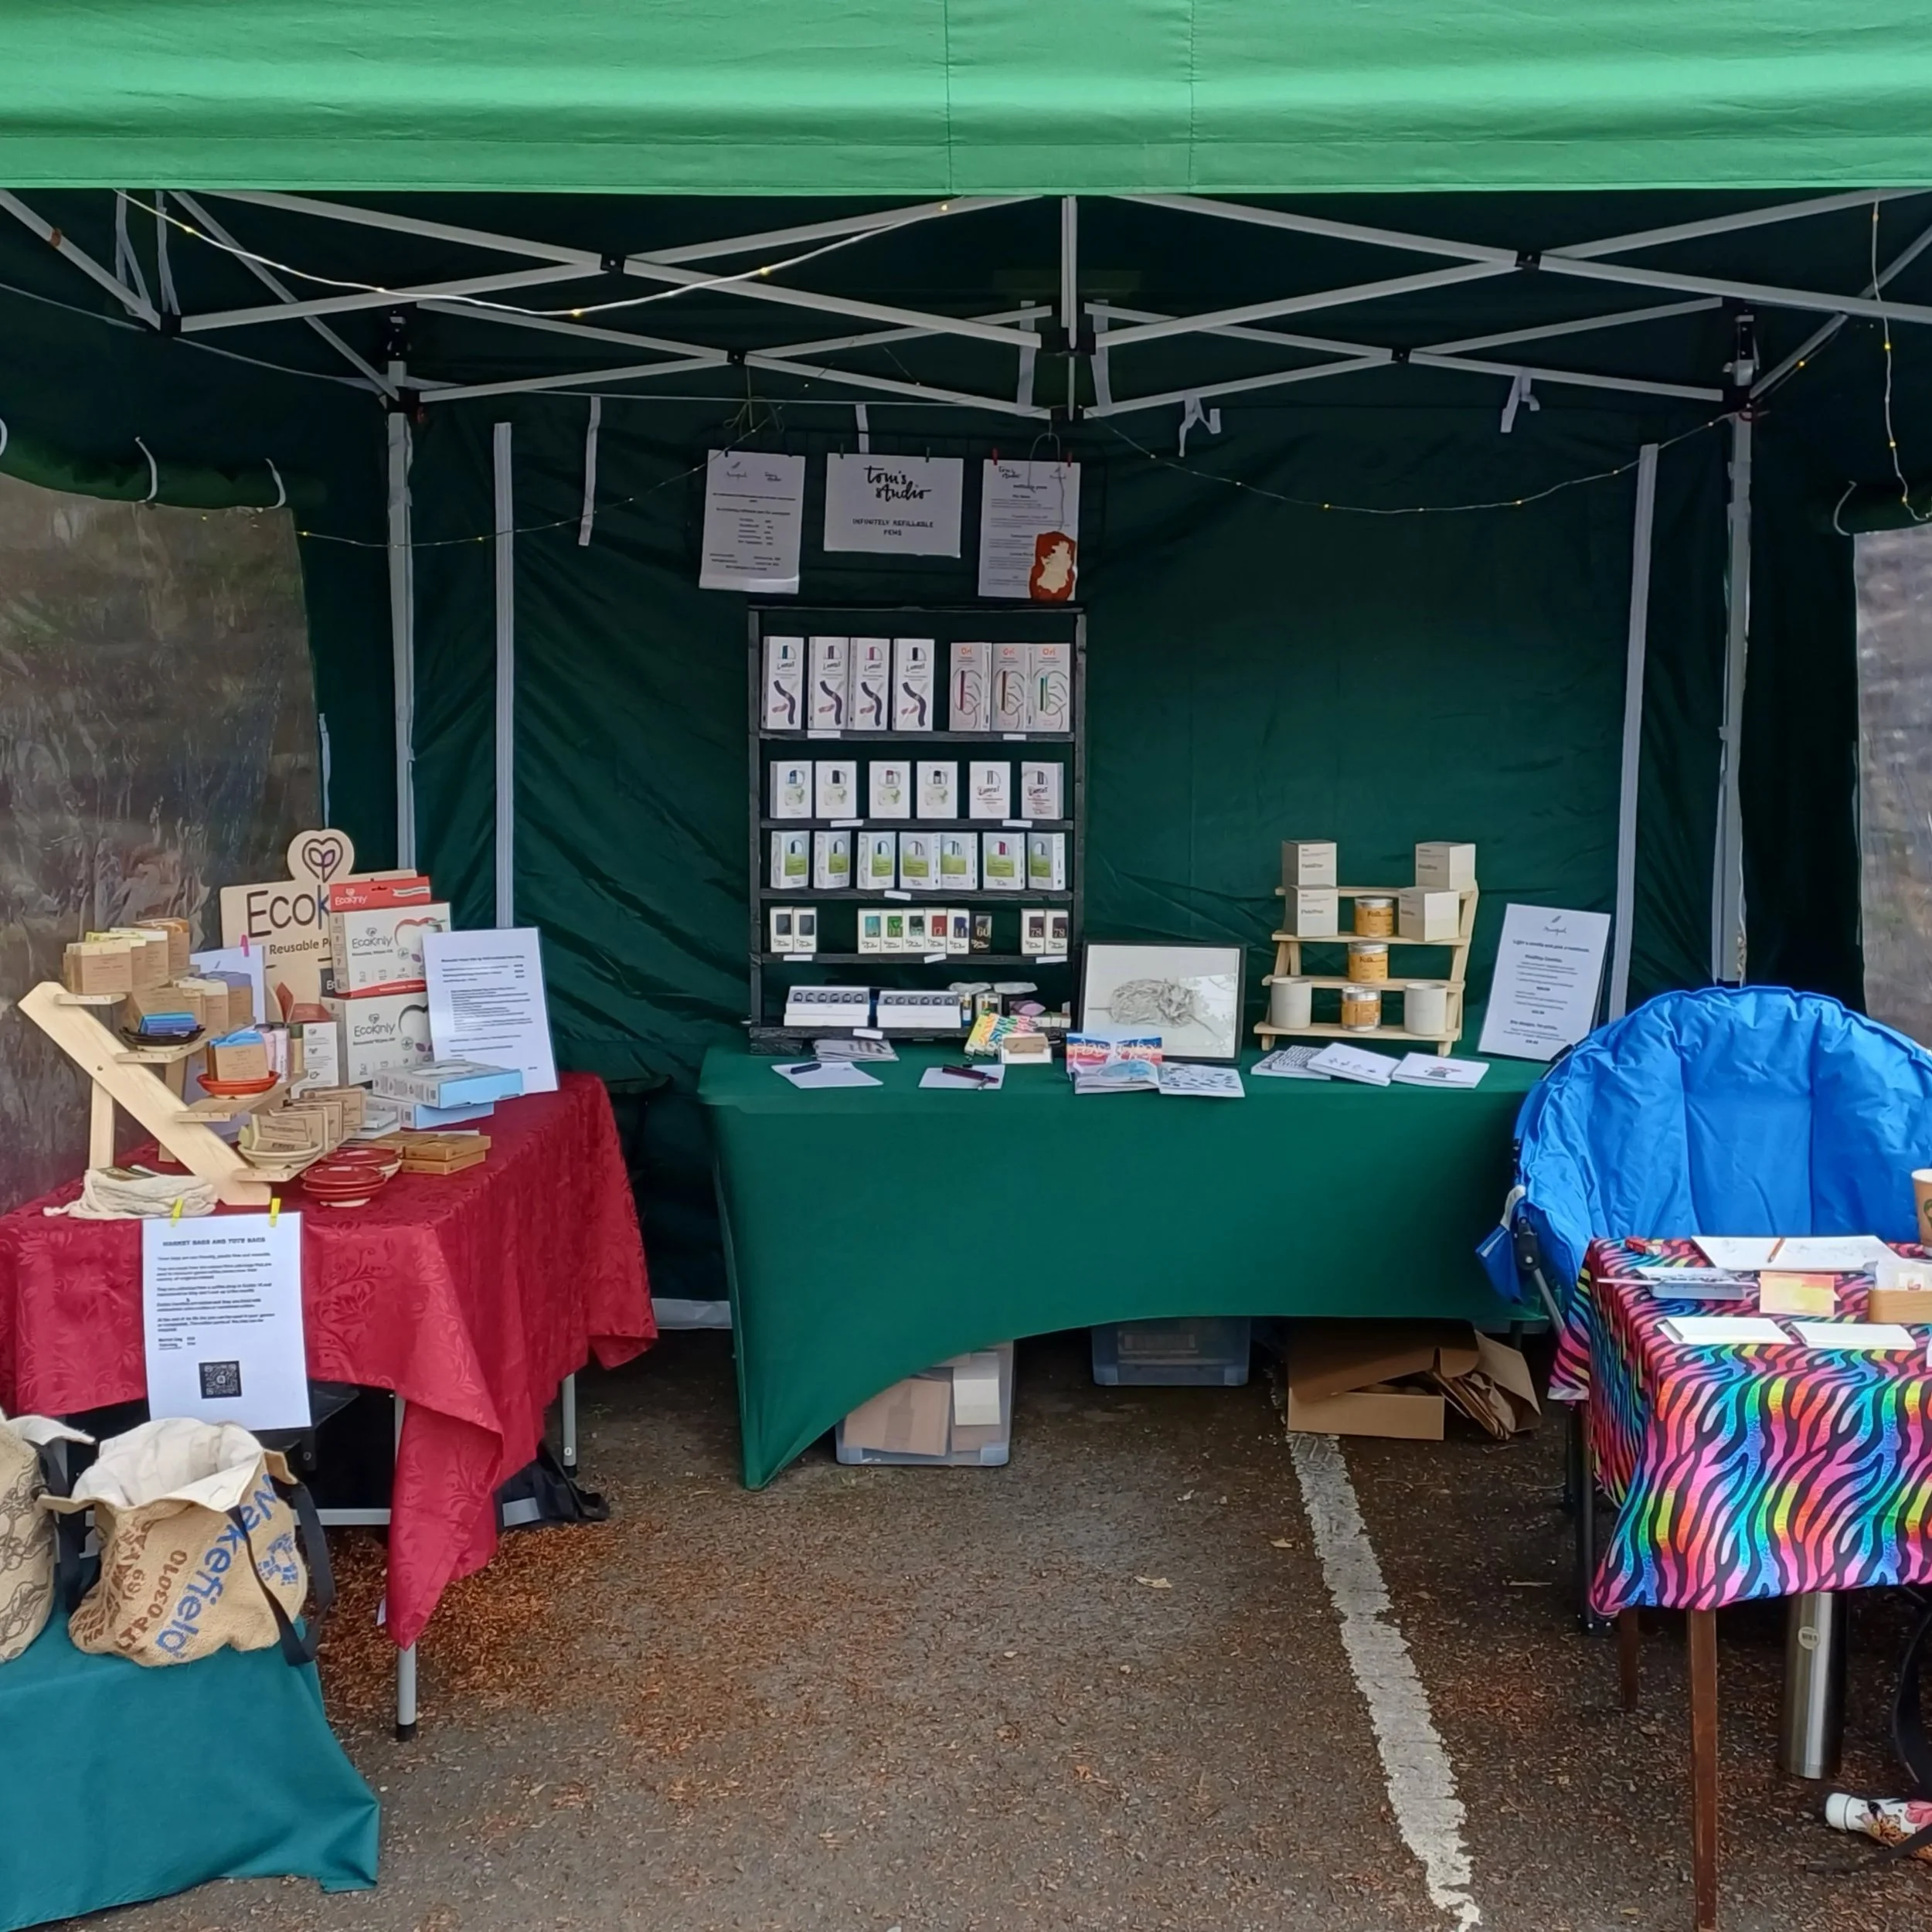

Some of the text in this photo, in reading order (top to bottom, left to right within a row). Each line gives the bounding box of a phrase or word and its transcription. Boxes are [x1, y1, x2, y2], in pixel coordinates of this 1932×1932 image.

[876, 481, 932, 502] studio
[852, 518, 934, 528] INFINITELY REFILLABLE
[270, 940, 319, 954] Reusable
